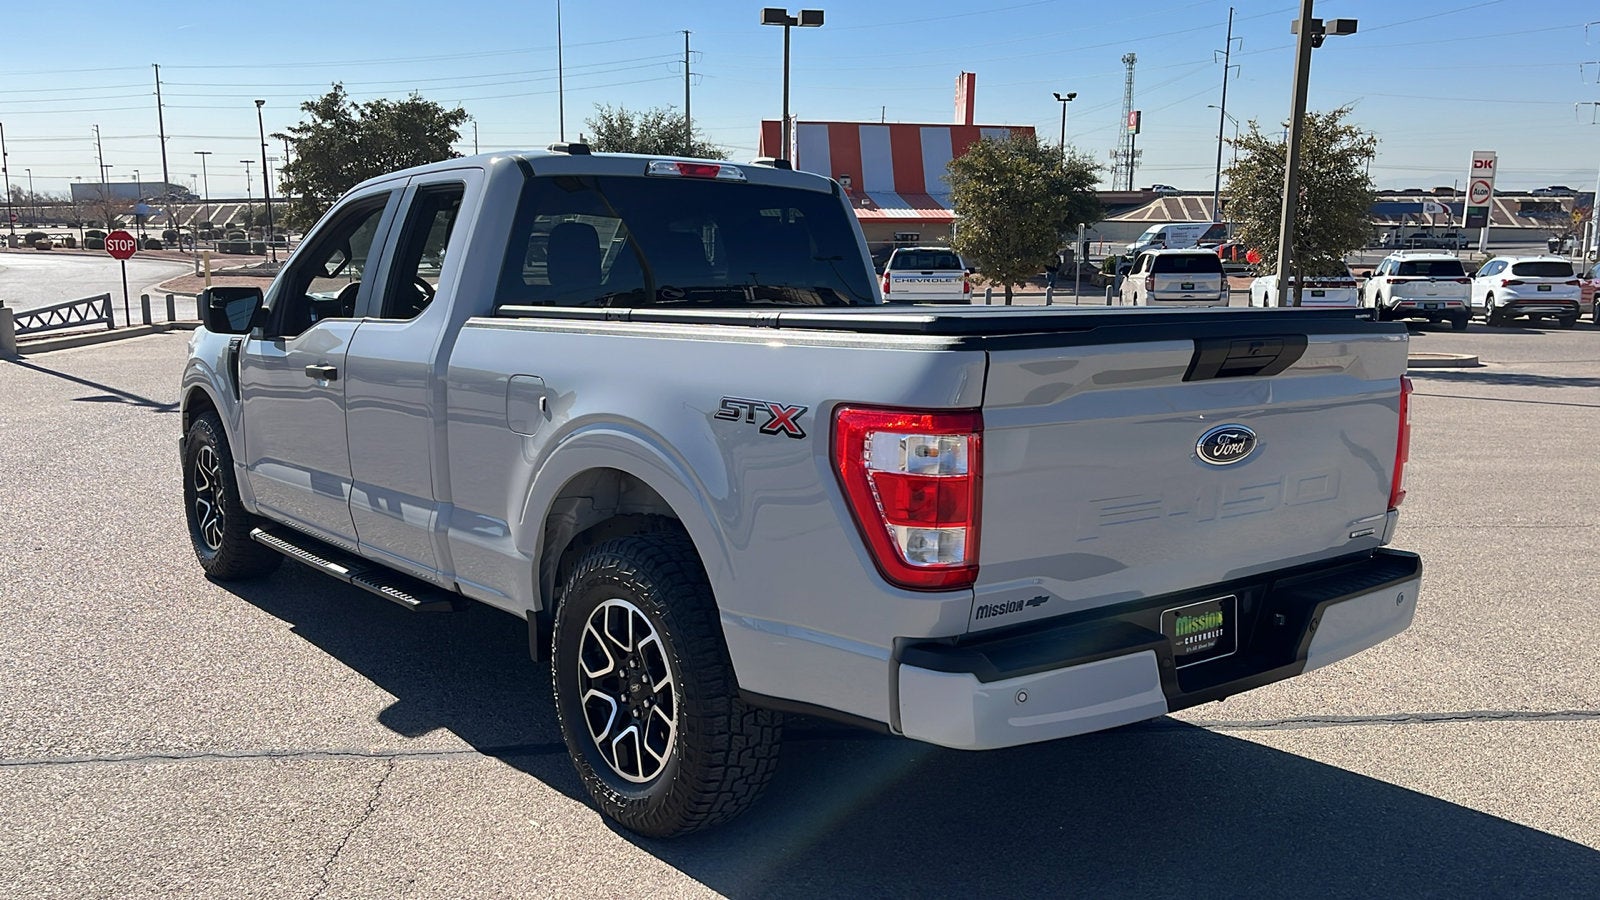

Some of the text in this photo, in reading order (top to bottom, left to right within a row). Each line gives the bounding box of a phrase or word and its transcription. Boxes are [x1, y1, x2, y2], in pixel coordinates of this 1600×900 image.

[1473, 159, 1493, 168] DK
[107, 239, 135, 251] STOP
[713, 395, 809, 440] STX
[1213, 433, 1246, 457] Ford
[1184, 628, 1223, 644] CHEVROLET
